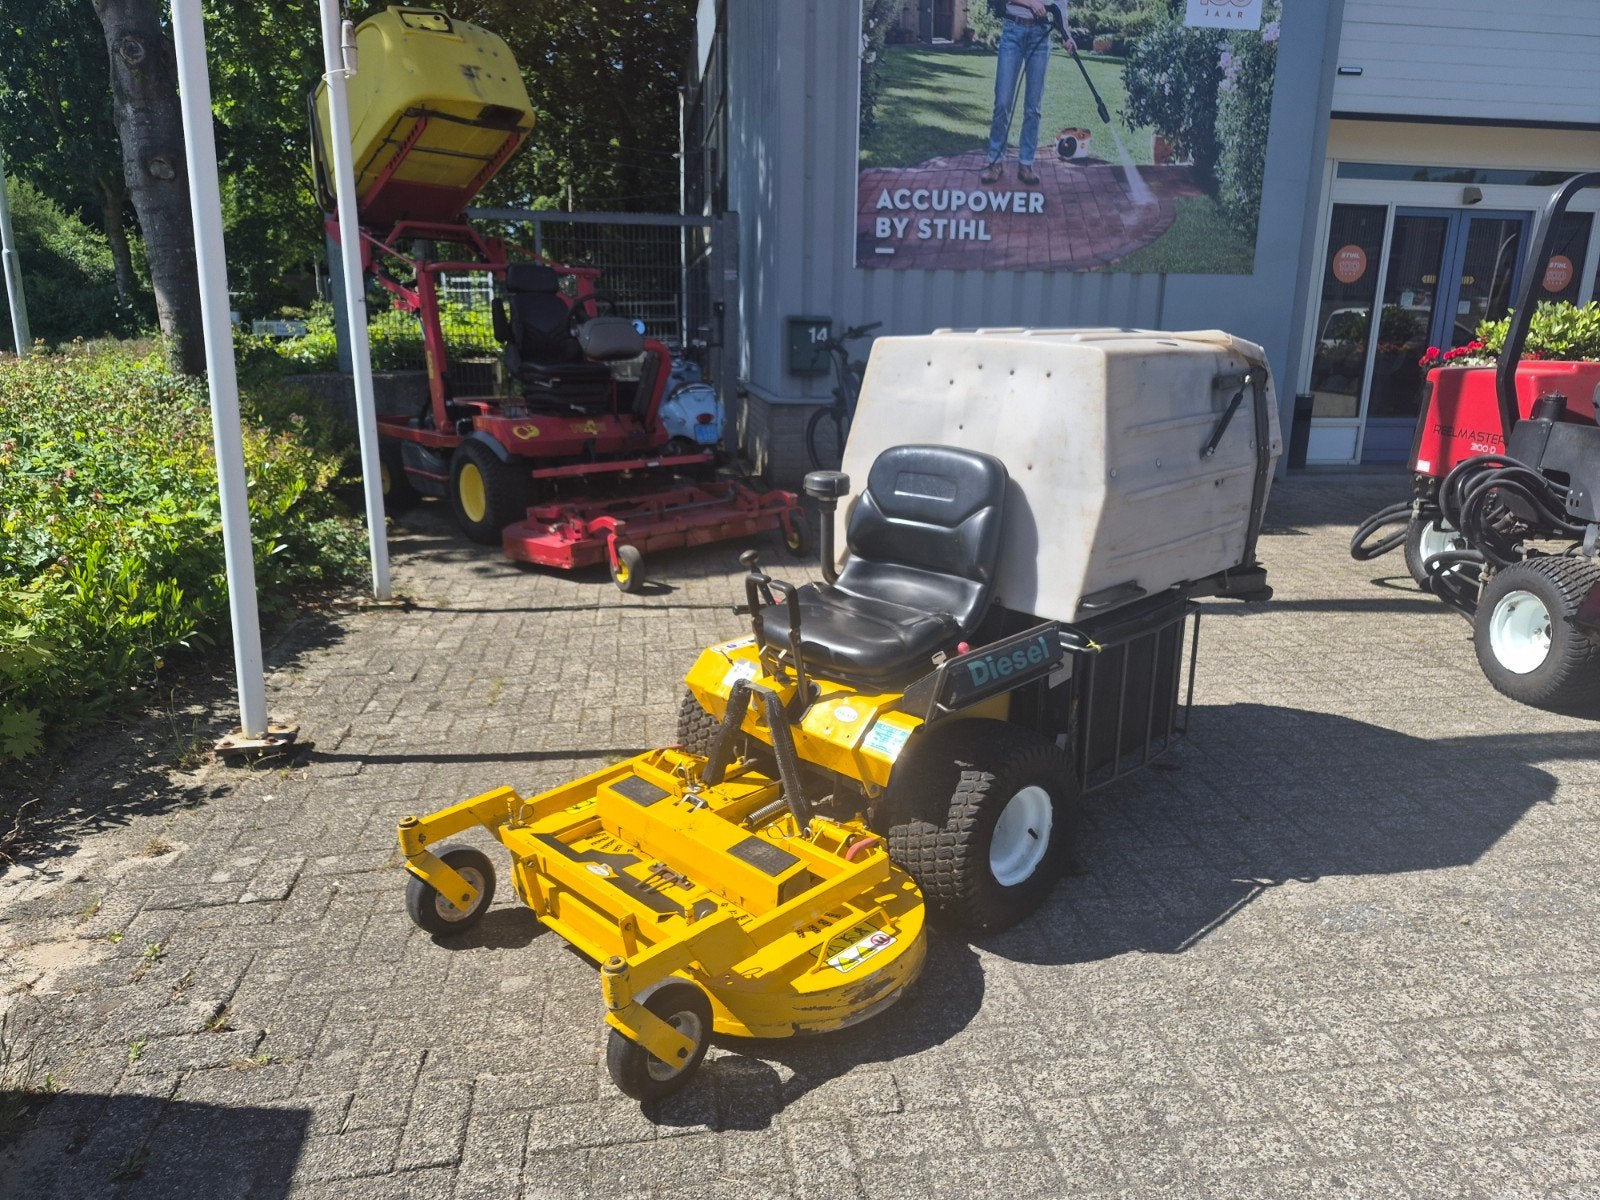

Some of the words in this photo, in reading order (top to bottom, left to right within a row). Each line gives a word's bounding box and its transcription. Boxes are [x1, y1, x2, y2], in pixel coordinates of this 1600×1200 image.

[1204, 9, 1243, 19] JAAR
[876, 188, 1045, 214] ACCUPOWER
[876, 217, 909, 239] BY
[918, 218, 992, 241] STIHL
[808, 327, 828, 343] 14
[1433, 424, 1505, 446] REELMASTER
[1490, 446, 1496, 454] D
[967, 636, 1050, 687] Diesel
